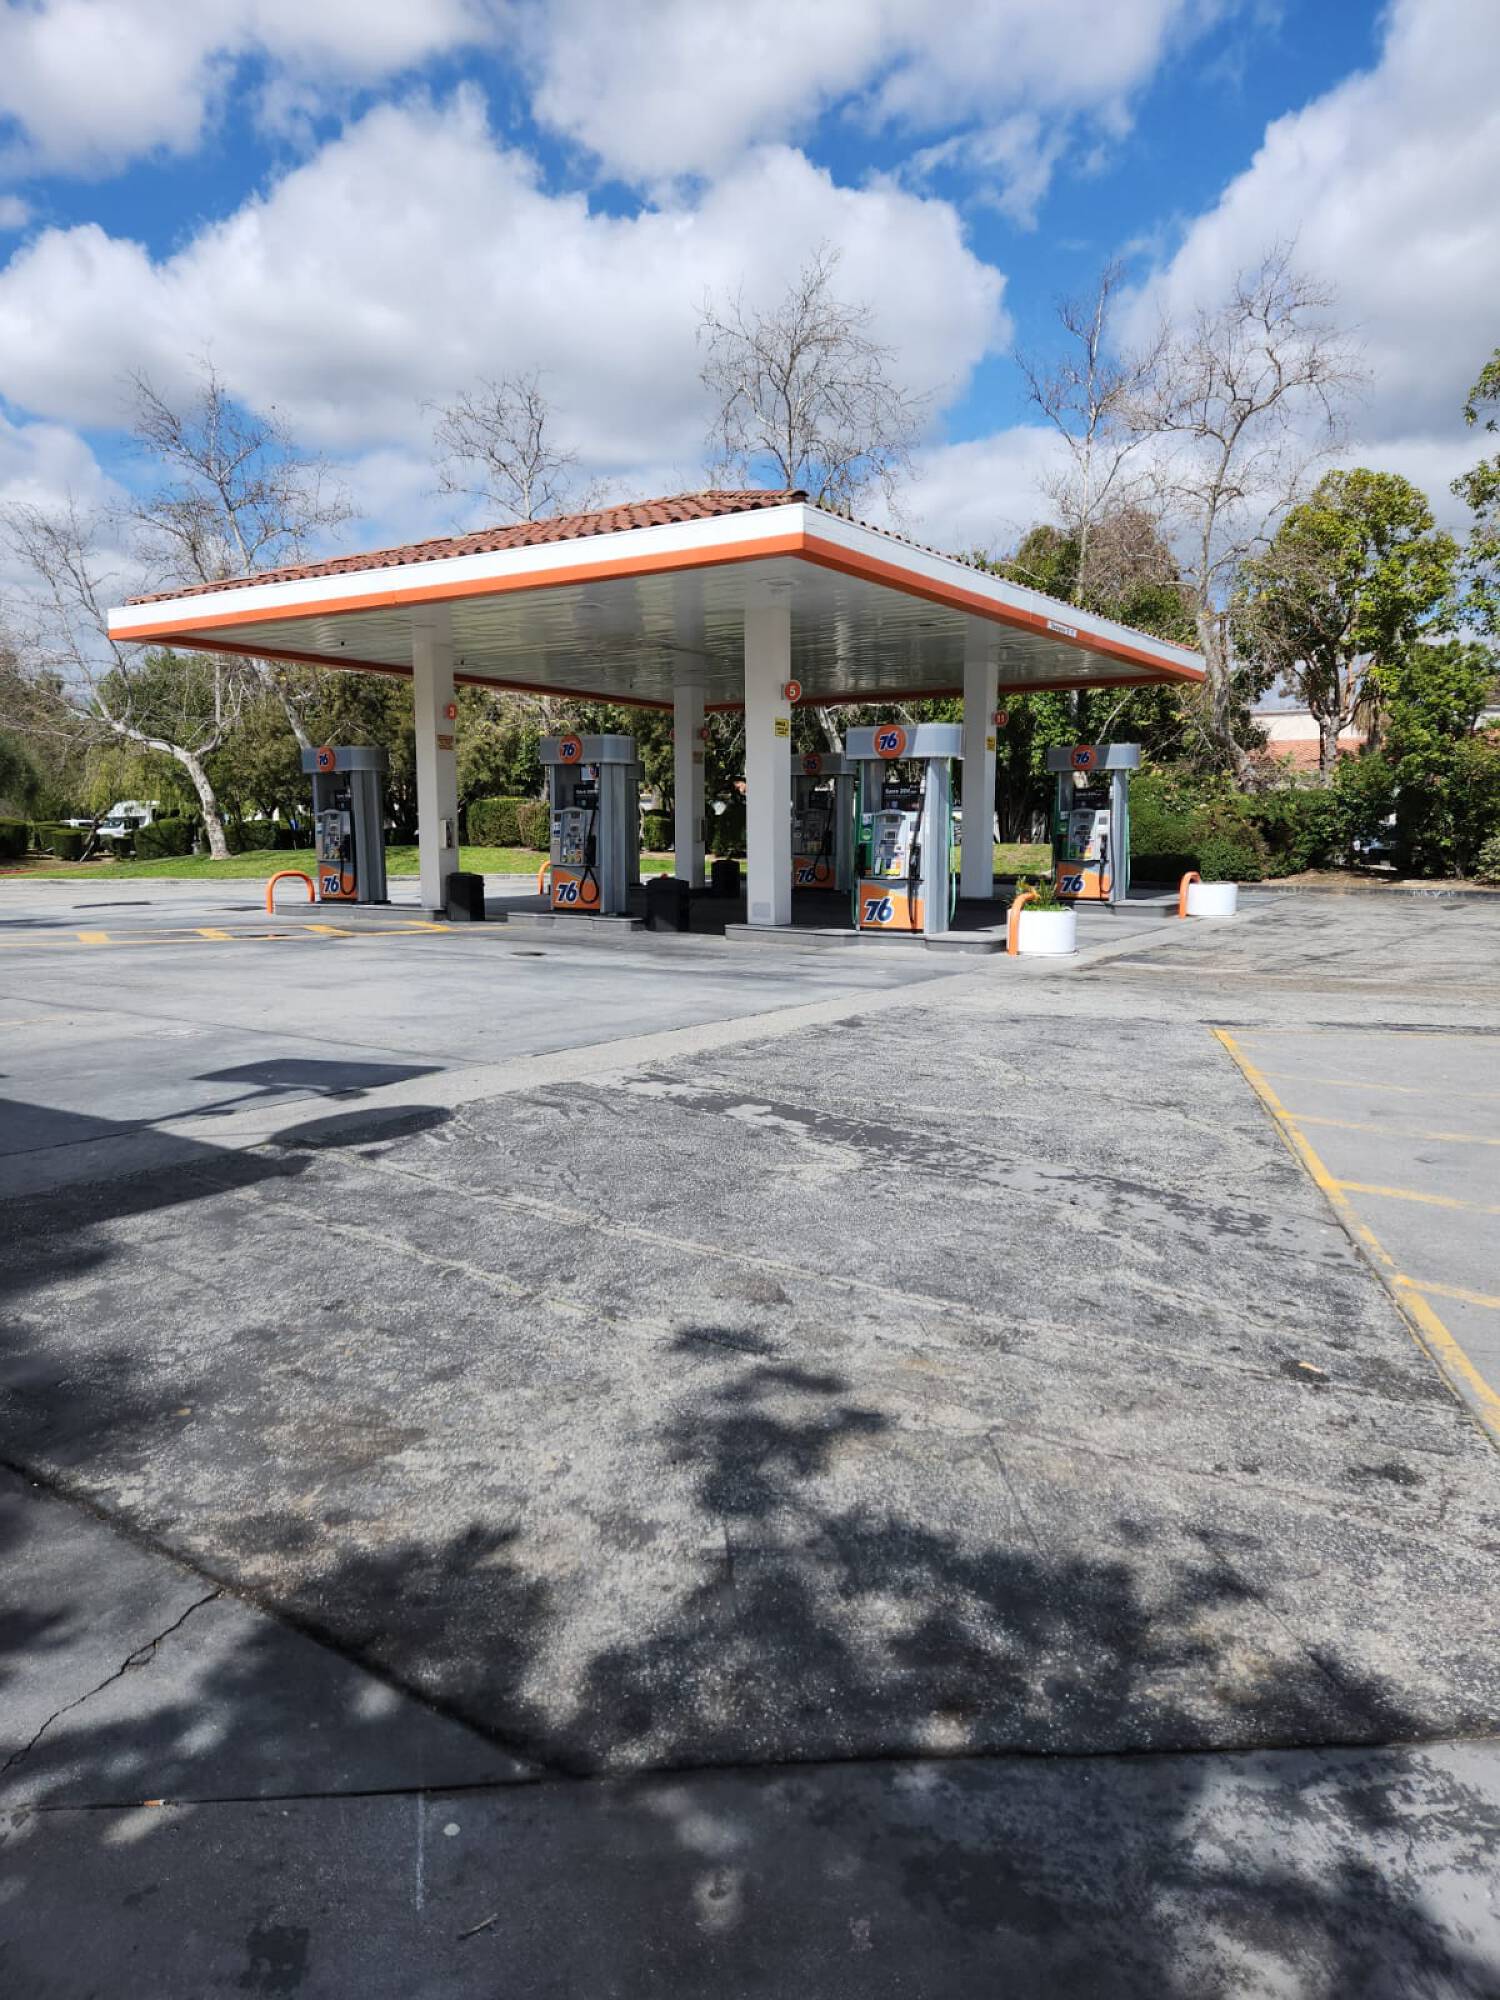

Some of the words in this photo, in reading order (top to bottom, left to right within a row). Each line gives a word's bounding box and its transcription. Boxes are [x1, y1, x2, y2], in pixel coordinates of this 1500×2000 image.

[560, 743, 577, 757] 76
[879, 731, 898, 750] 76
[319, 753, 329, 766] 76
[1074, 754, 1090, 765] 76
[322, 874, 341, 894] 76
[797, 867, 816, 884] 76
[1060, 873, 1085, 893] 76
[556, 881, 578, 903] 76
[864, 896, 894, 922] 76
